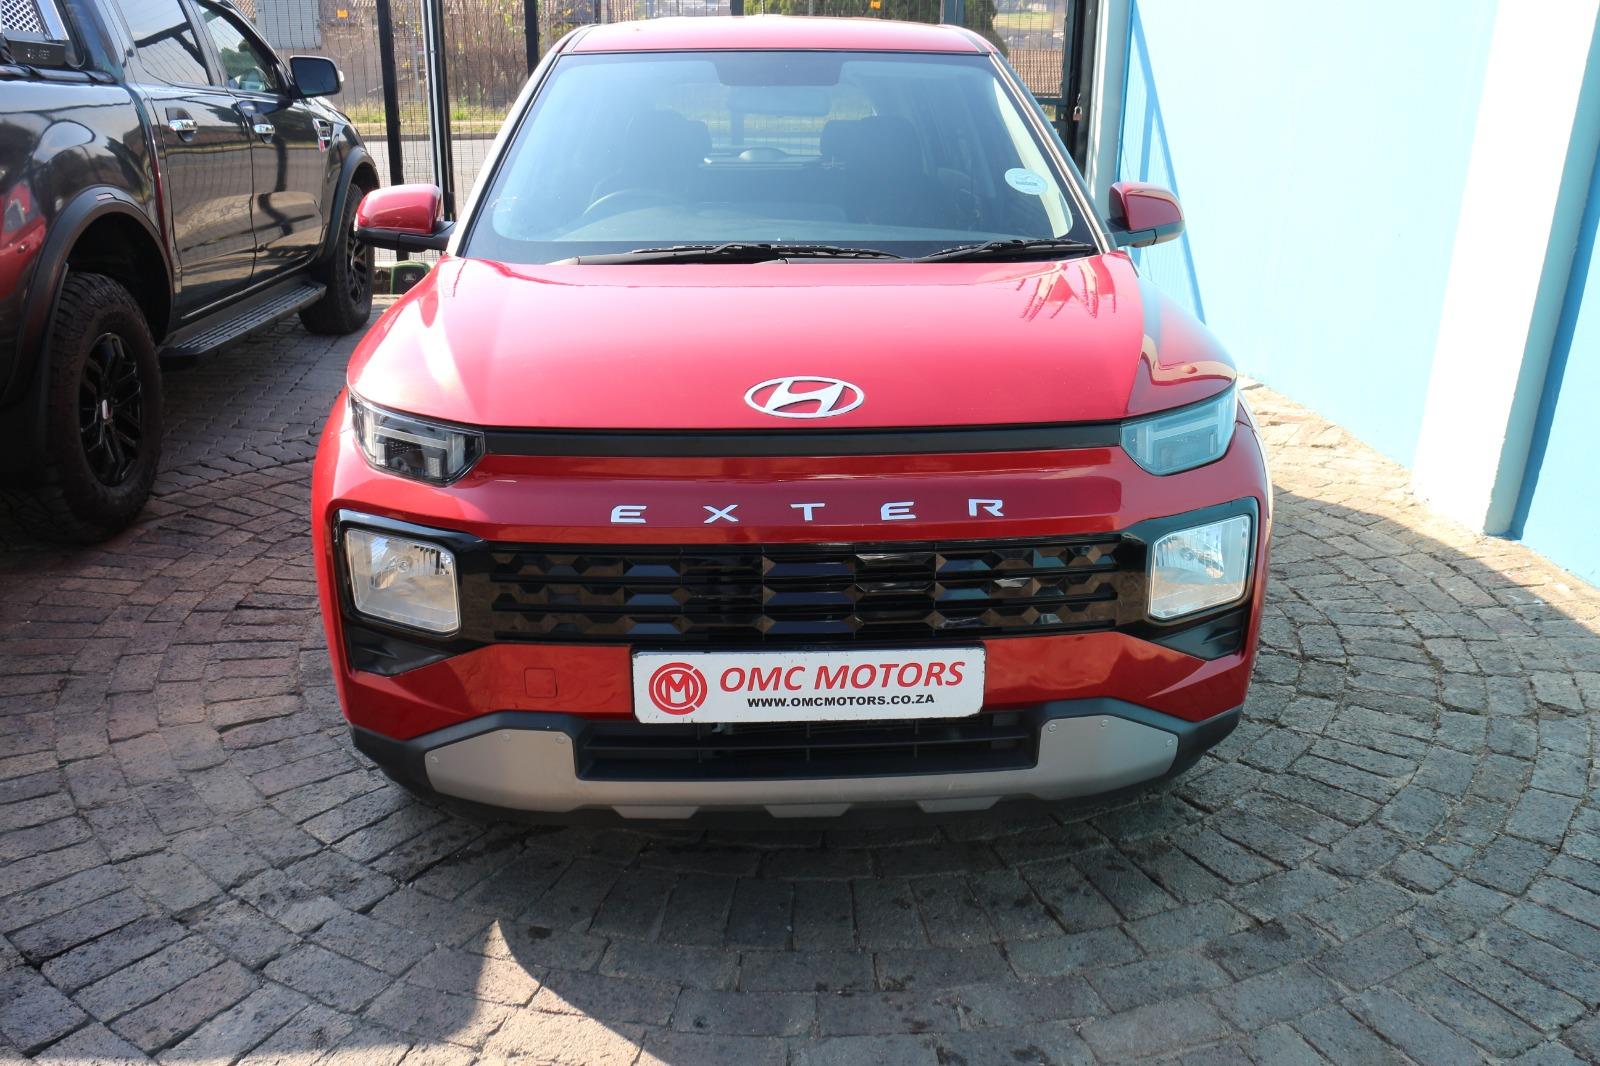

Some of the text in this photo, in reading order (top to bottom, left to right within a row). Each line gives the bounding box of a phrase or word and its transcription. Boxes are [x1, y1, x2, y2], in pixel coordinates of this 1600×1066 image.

[610, 498, 1005, 524] EXTER
[719, 661, 965, 692] OMC MOTORS
[747, 694, 935, 708] WWW.OMCMOTORS.CO.ZA
